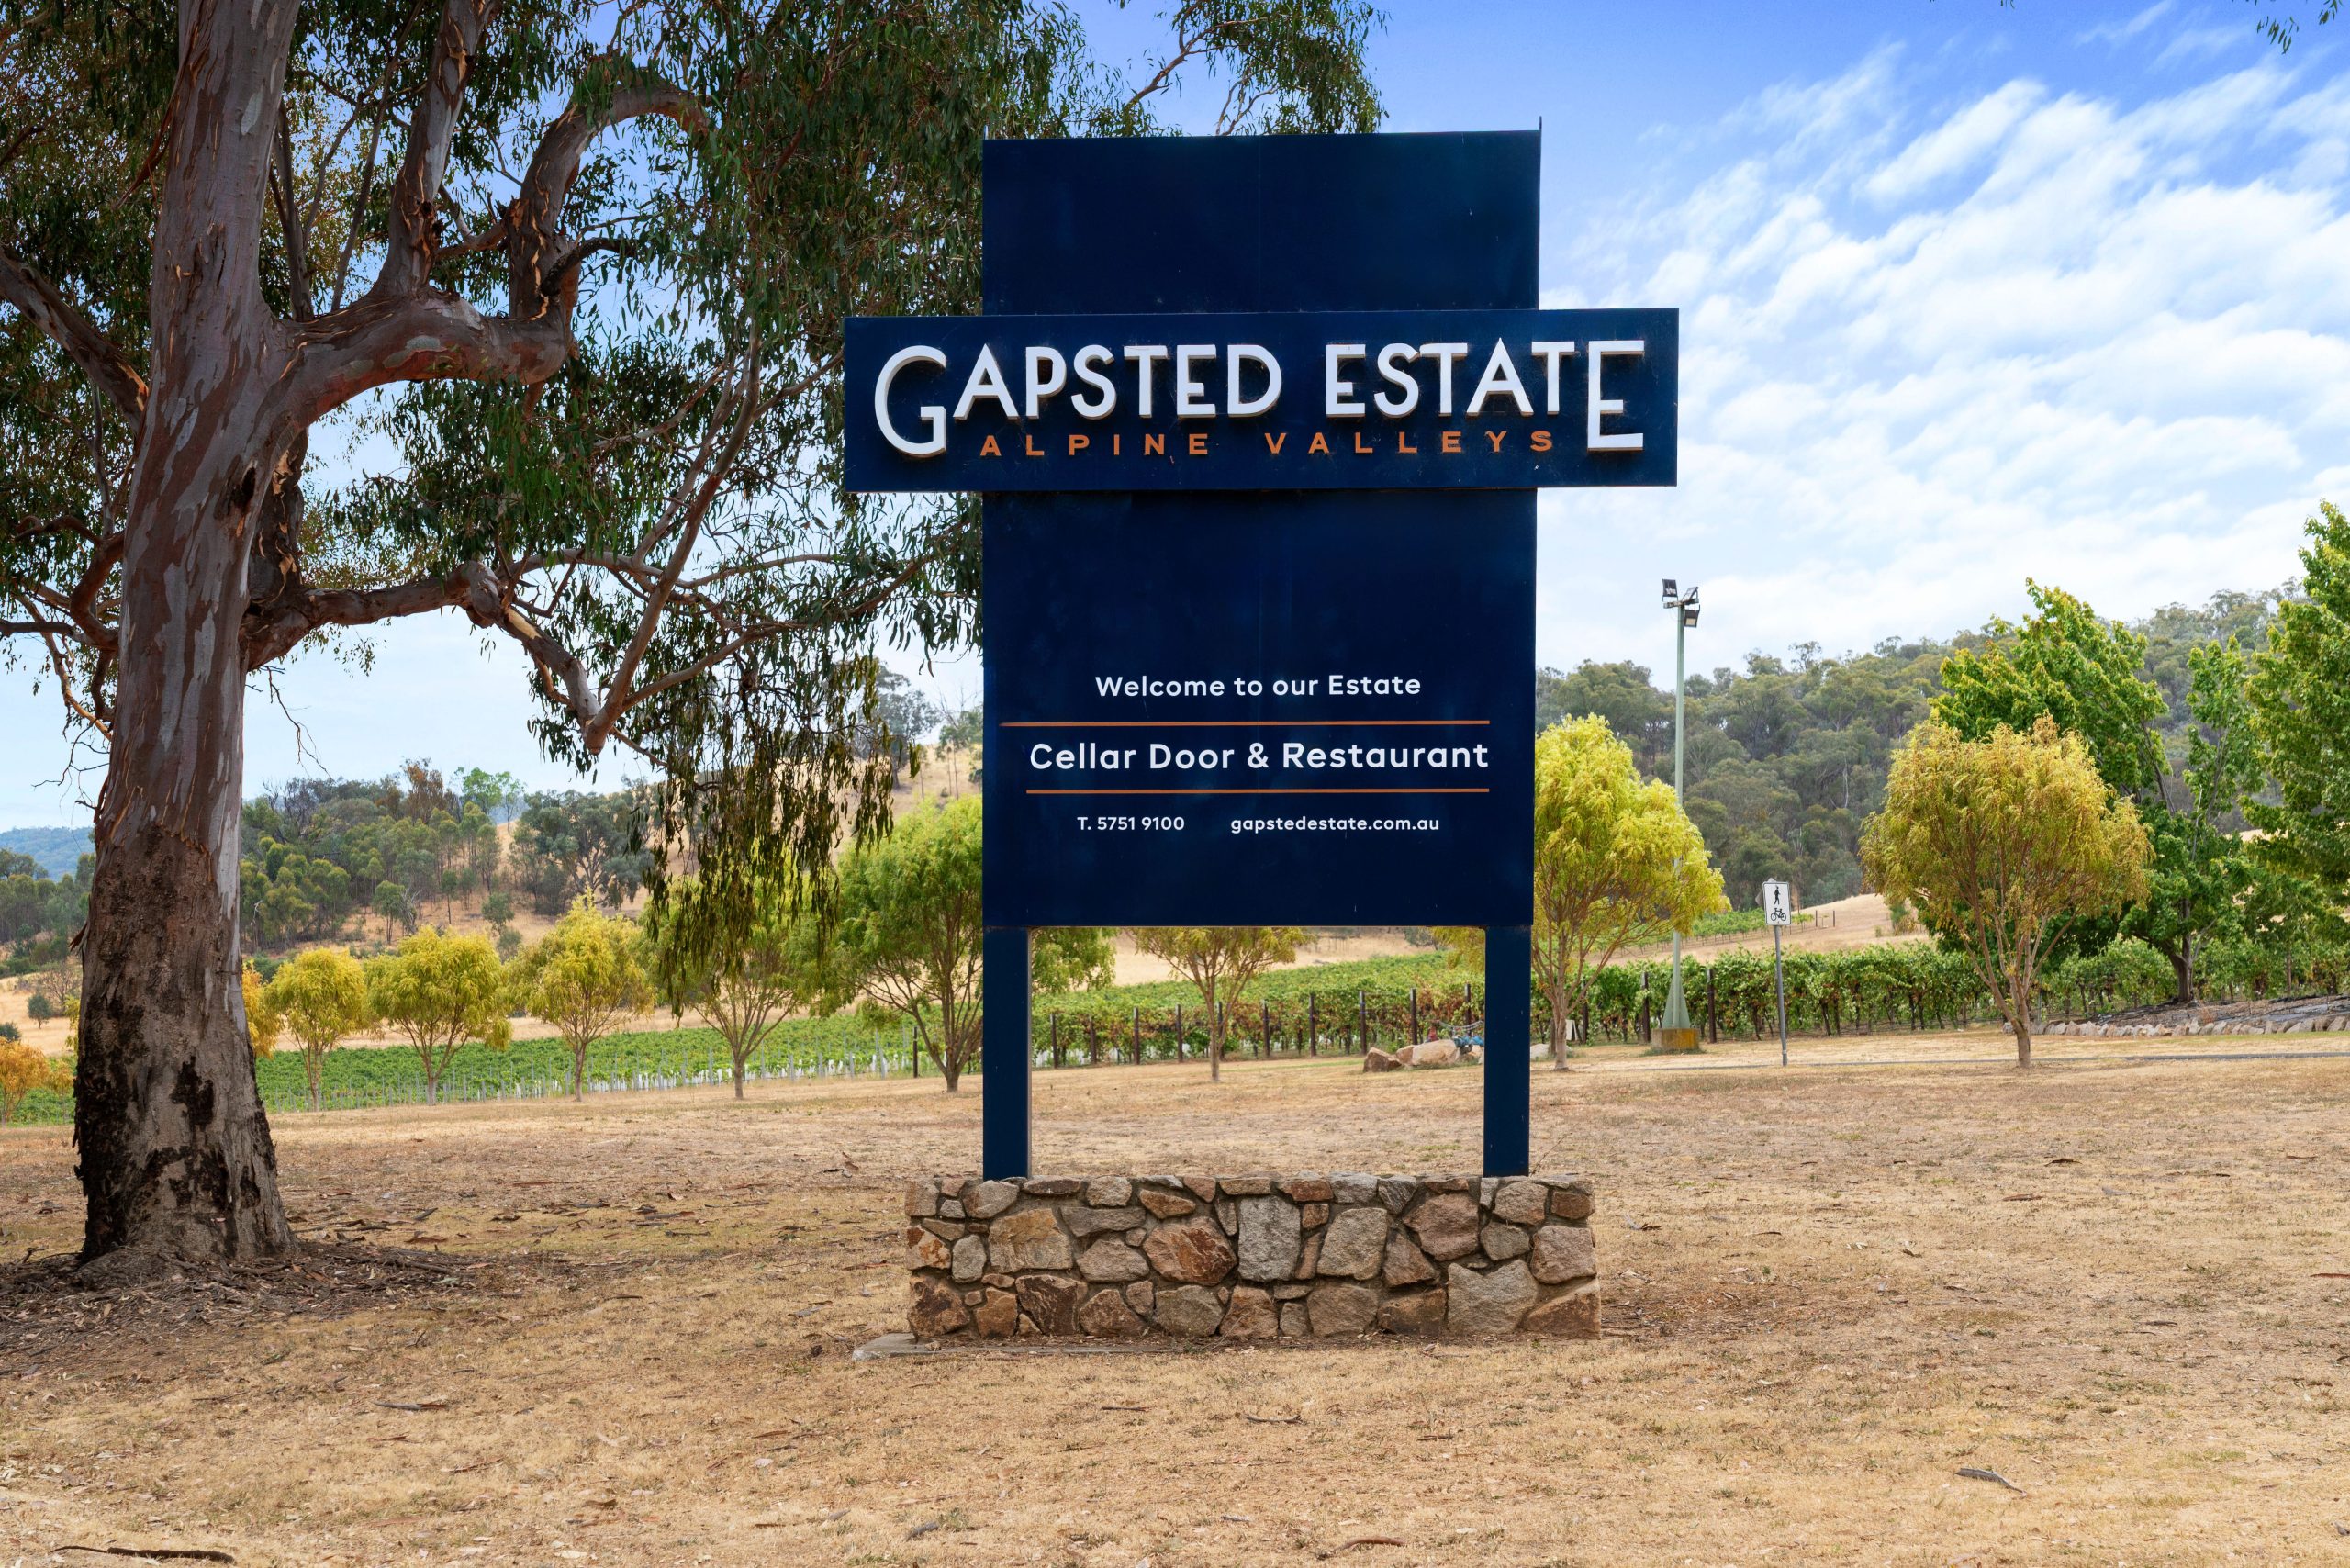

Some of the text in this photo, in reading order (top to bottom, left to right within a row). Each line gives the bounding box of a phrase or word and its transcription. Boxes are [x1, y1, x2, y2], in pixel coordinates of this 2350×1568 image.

[873, 337, 1646, 456] GAPSTED ESTATE
[979, 430, 1554, 457] ALPINE VALLEYS
[1094, 675, 1422, 697] Welcome to our Estate
[1030, 742, 1489, 770] Cellar Door & Restaurant
[1077, 816, 1185, 831] T. 5751 9100
[1230, 815, 1440, 834] gapstedestate.com.au
